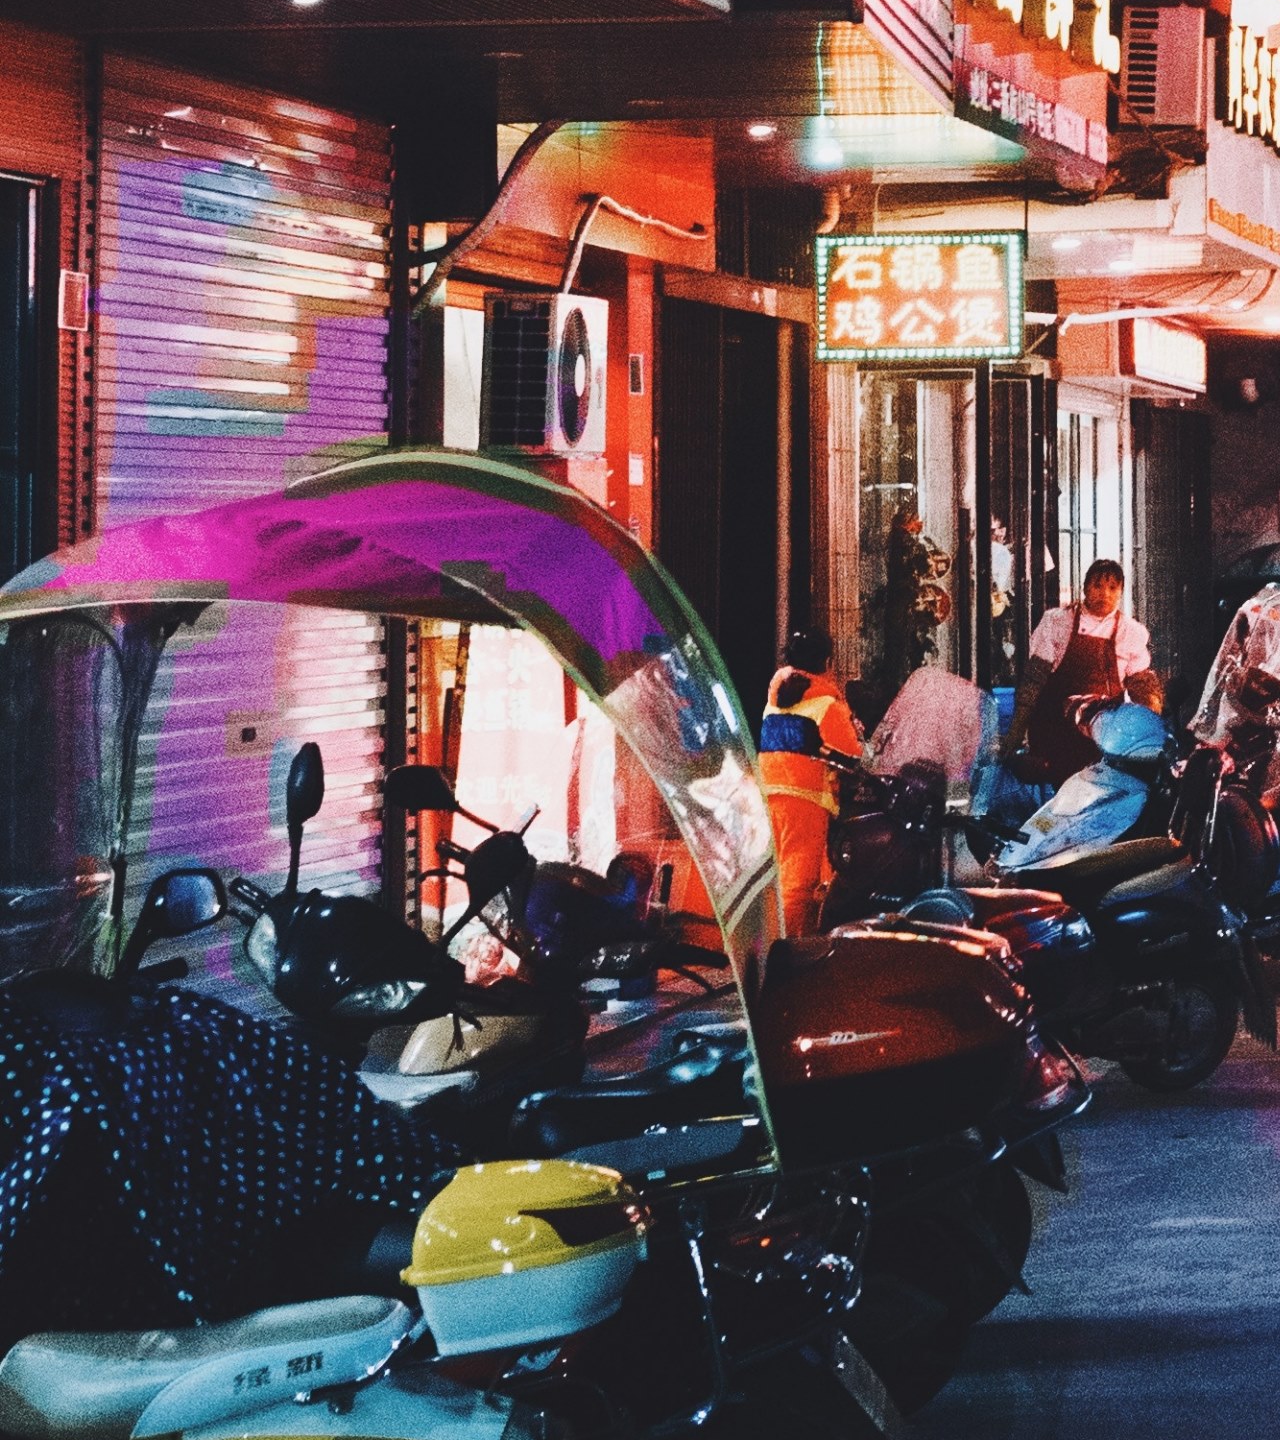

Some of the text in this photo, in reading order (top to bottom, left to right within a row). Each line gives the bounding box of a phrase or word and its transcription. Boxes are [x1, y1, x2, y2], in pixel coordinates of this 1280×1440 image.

[831, 244, 1004, 290] 石锅鱼
[831, 297, 1004, 345] 鸡公煲
